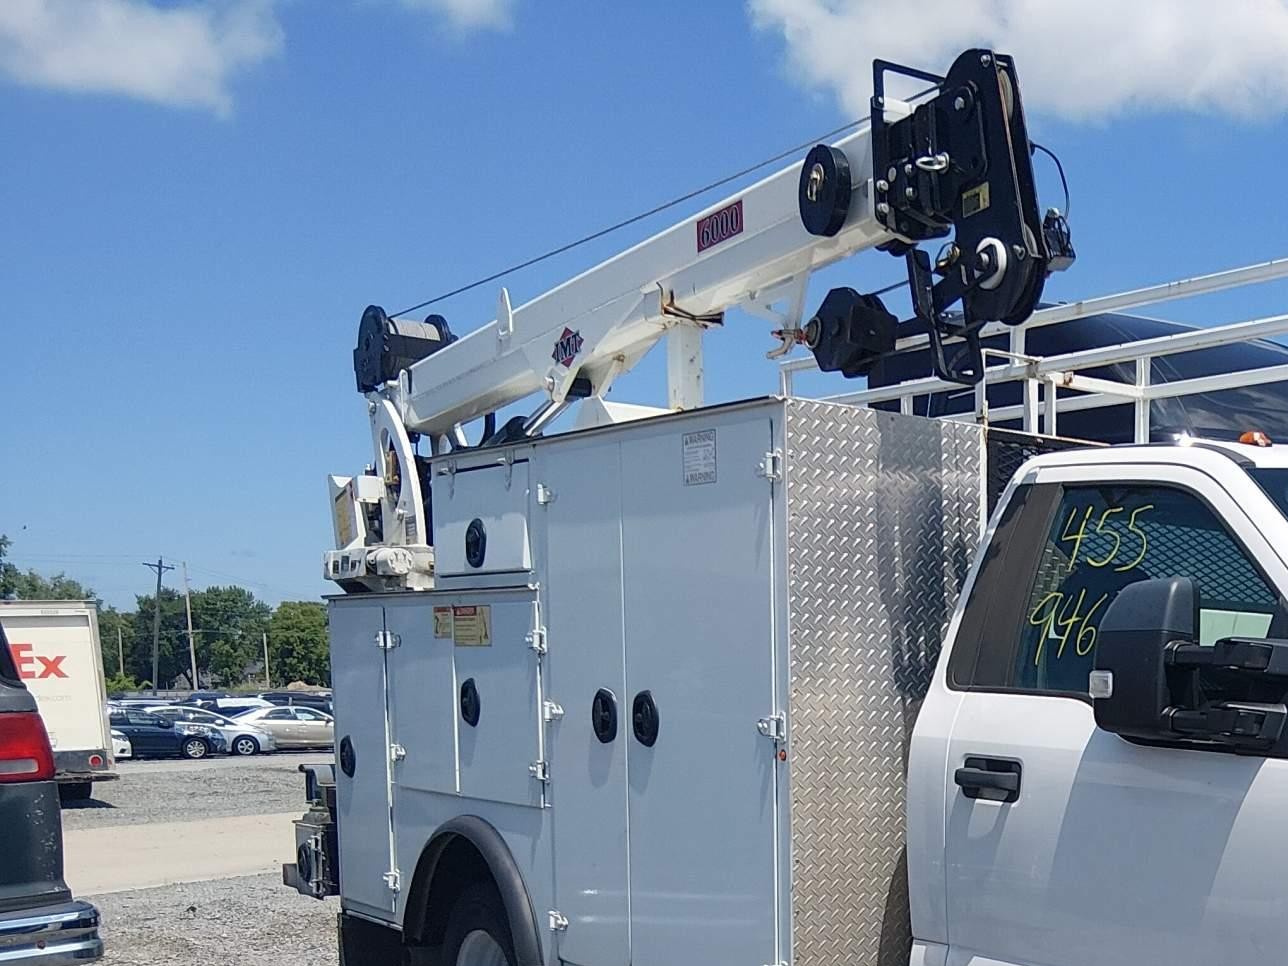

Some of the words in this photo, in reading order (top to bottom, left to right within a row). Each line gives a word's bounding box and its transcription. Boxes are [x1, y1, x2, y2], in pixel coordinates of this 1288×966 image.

[700, 205, 740, 248] 6000
[554, 331, 581, 364] IMT
[1062, 505, 1154, 573] 455
